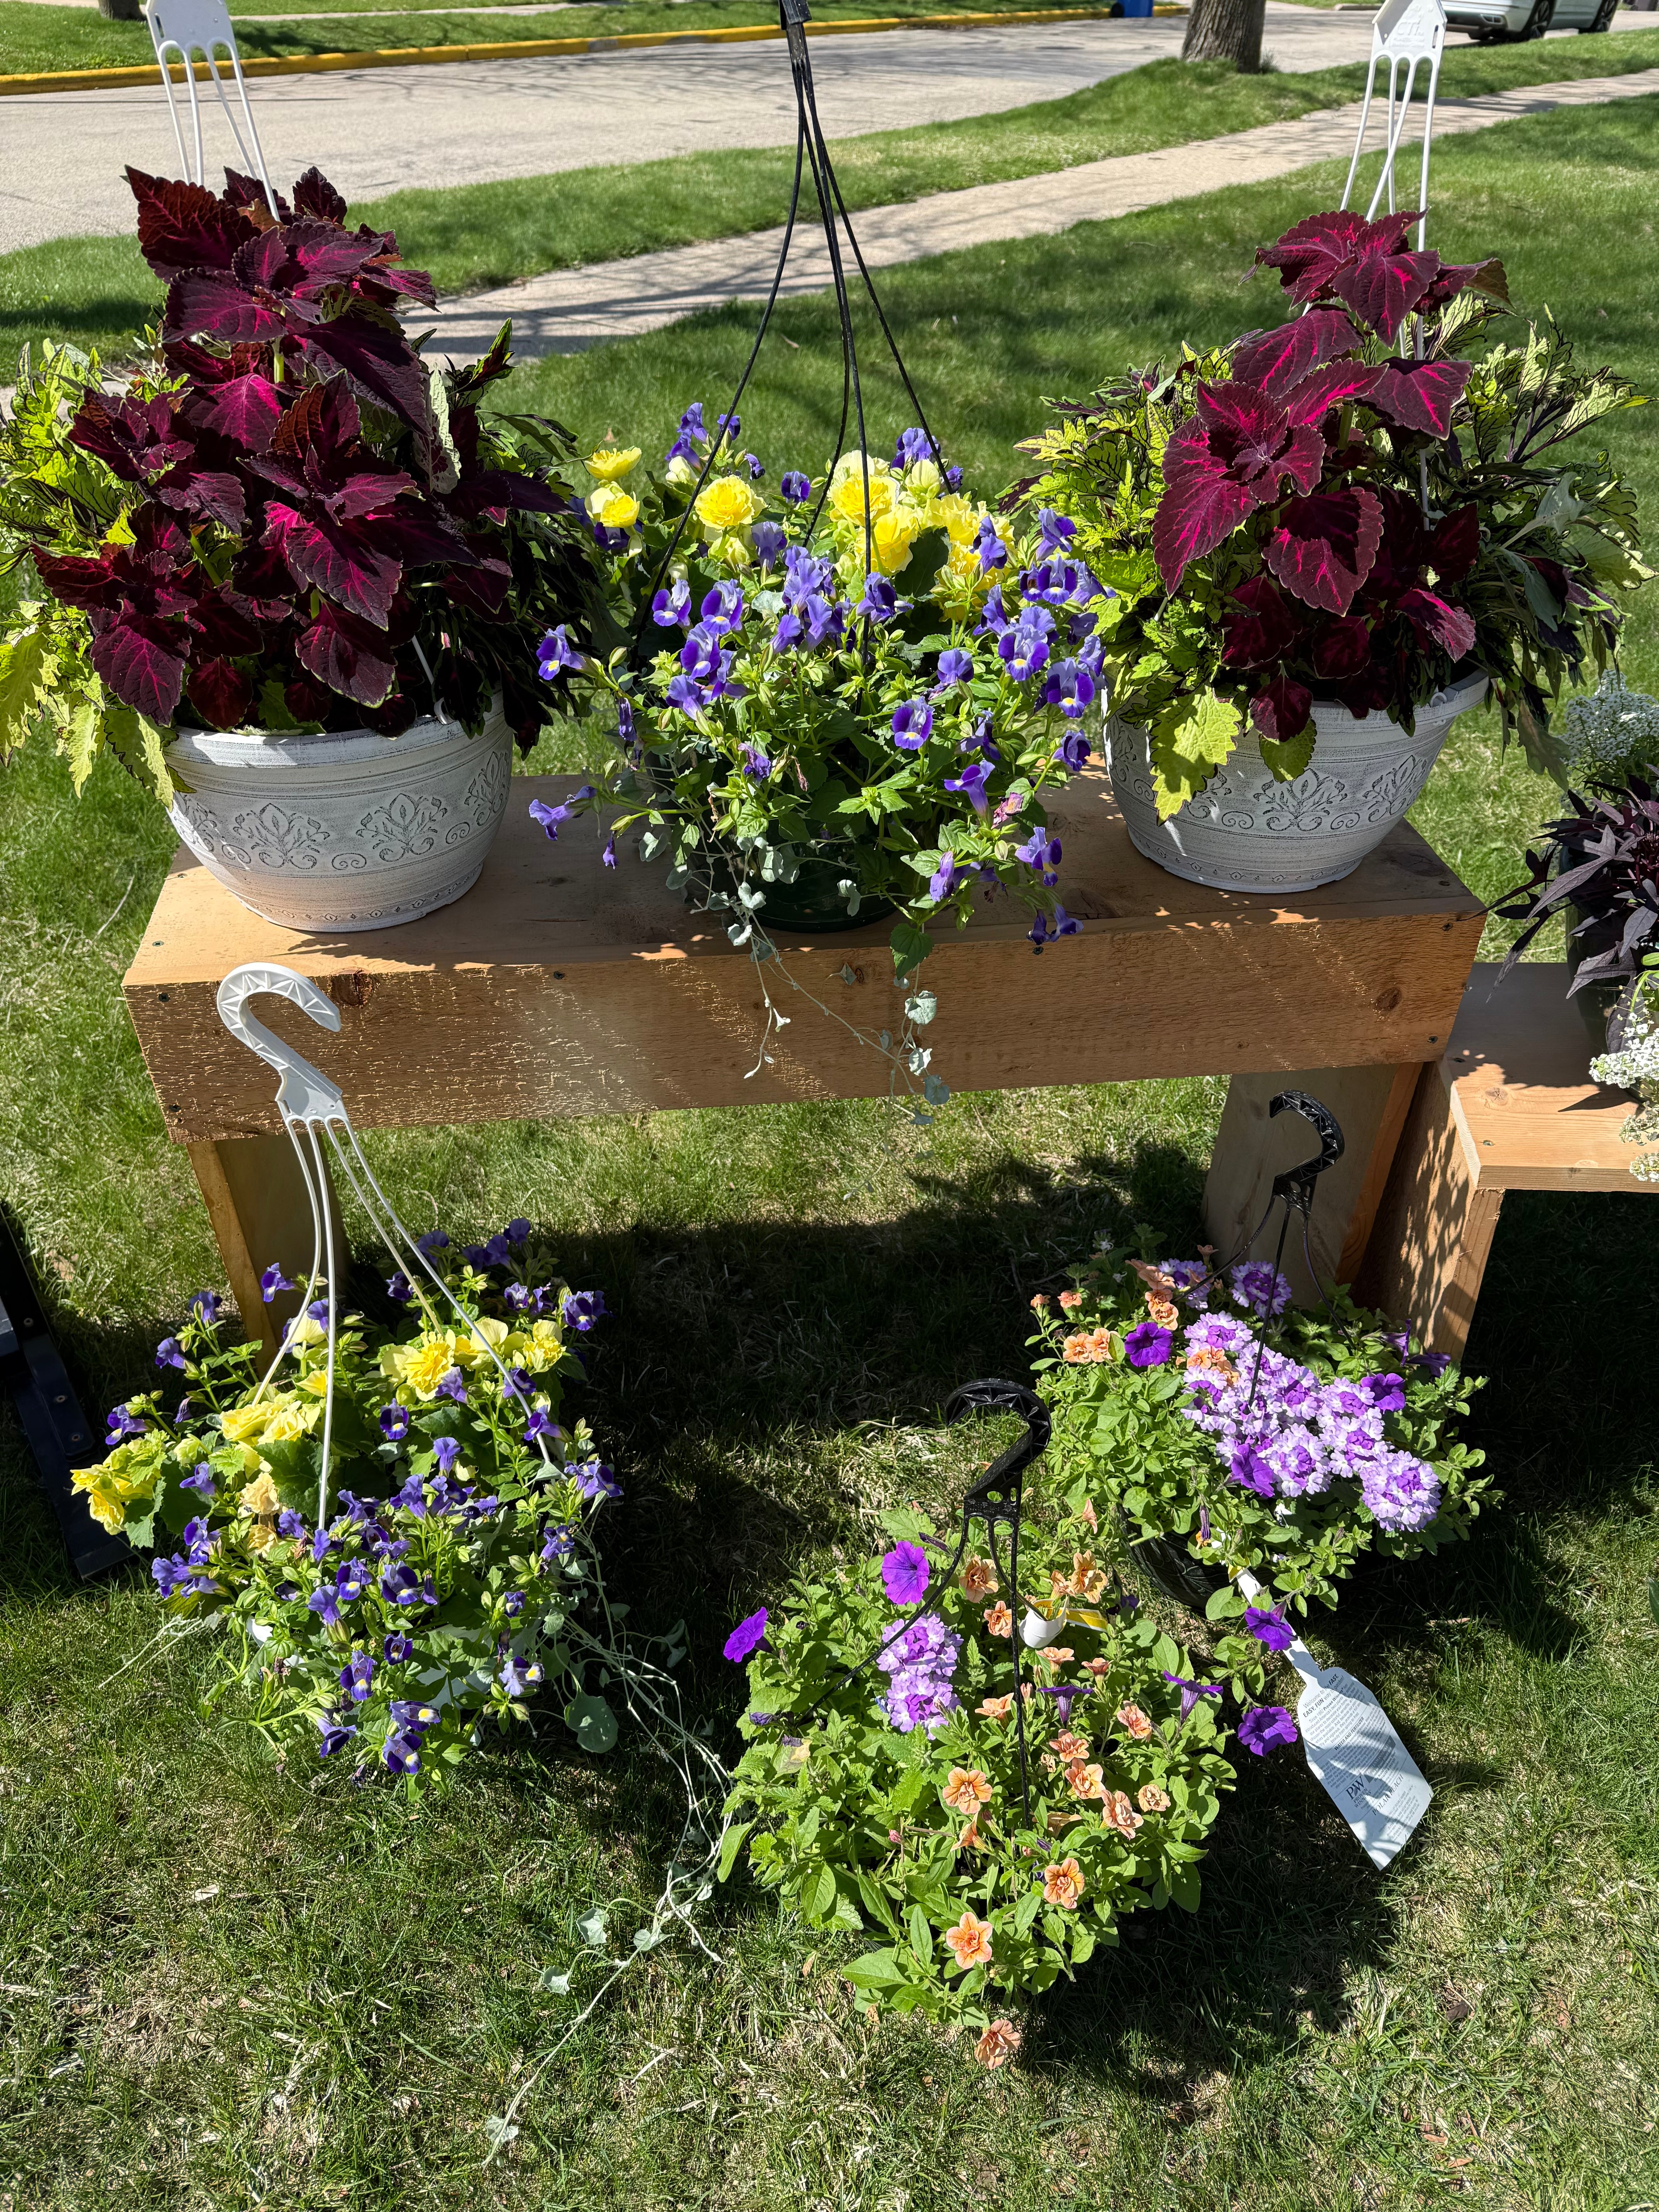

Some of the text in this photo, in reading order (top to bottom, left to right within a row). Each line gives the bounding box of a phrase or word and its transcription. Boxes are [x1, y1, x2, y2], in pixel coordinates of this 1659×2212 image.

[1302, 1693, 1321, 1709] Welcome
[1314, 1697, 1324, 1708] FUN
[1323, 1692, 1332, 1700] way
[1333, 1738, 1346, 1751] WATER
[1343, 1731, 1352, 1741] AND
[1350, 1716, 1365, 1734] FERTILIZER
[1353, 1787, 1368, 1803] PROVEN
[1371, 1793, 1391, 1816] POLAR
[1388, 1773, 1404, 1795] PEACH
